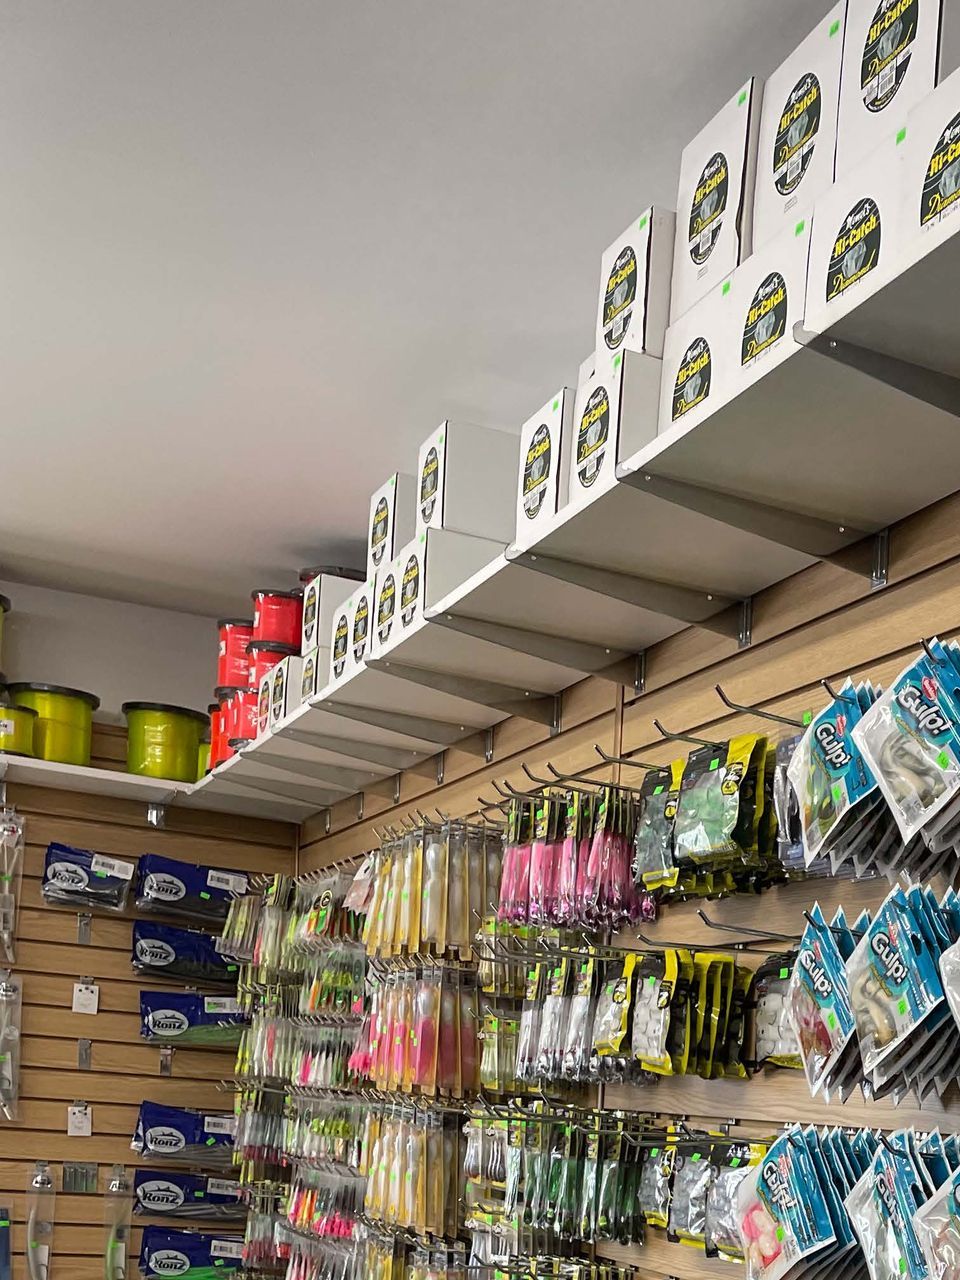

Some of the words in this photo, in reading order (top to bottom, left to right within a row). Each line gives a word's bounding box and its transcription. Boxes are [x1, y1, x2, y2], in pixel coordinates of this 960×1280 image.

[780, 85, 817, 131] Hi-Catch
[834, 216, 877, 258] Hi-Catch
[899, 686, 951, 739] Gulp!
[815, 721, 848, 770] Gulp!
[800, 951, 832, 998] Gulp!
[870, 931, 908, 984] Gulp!
